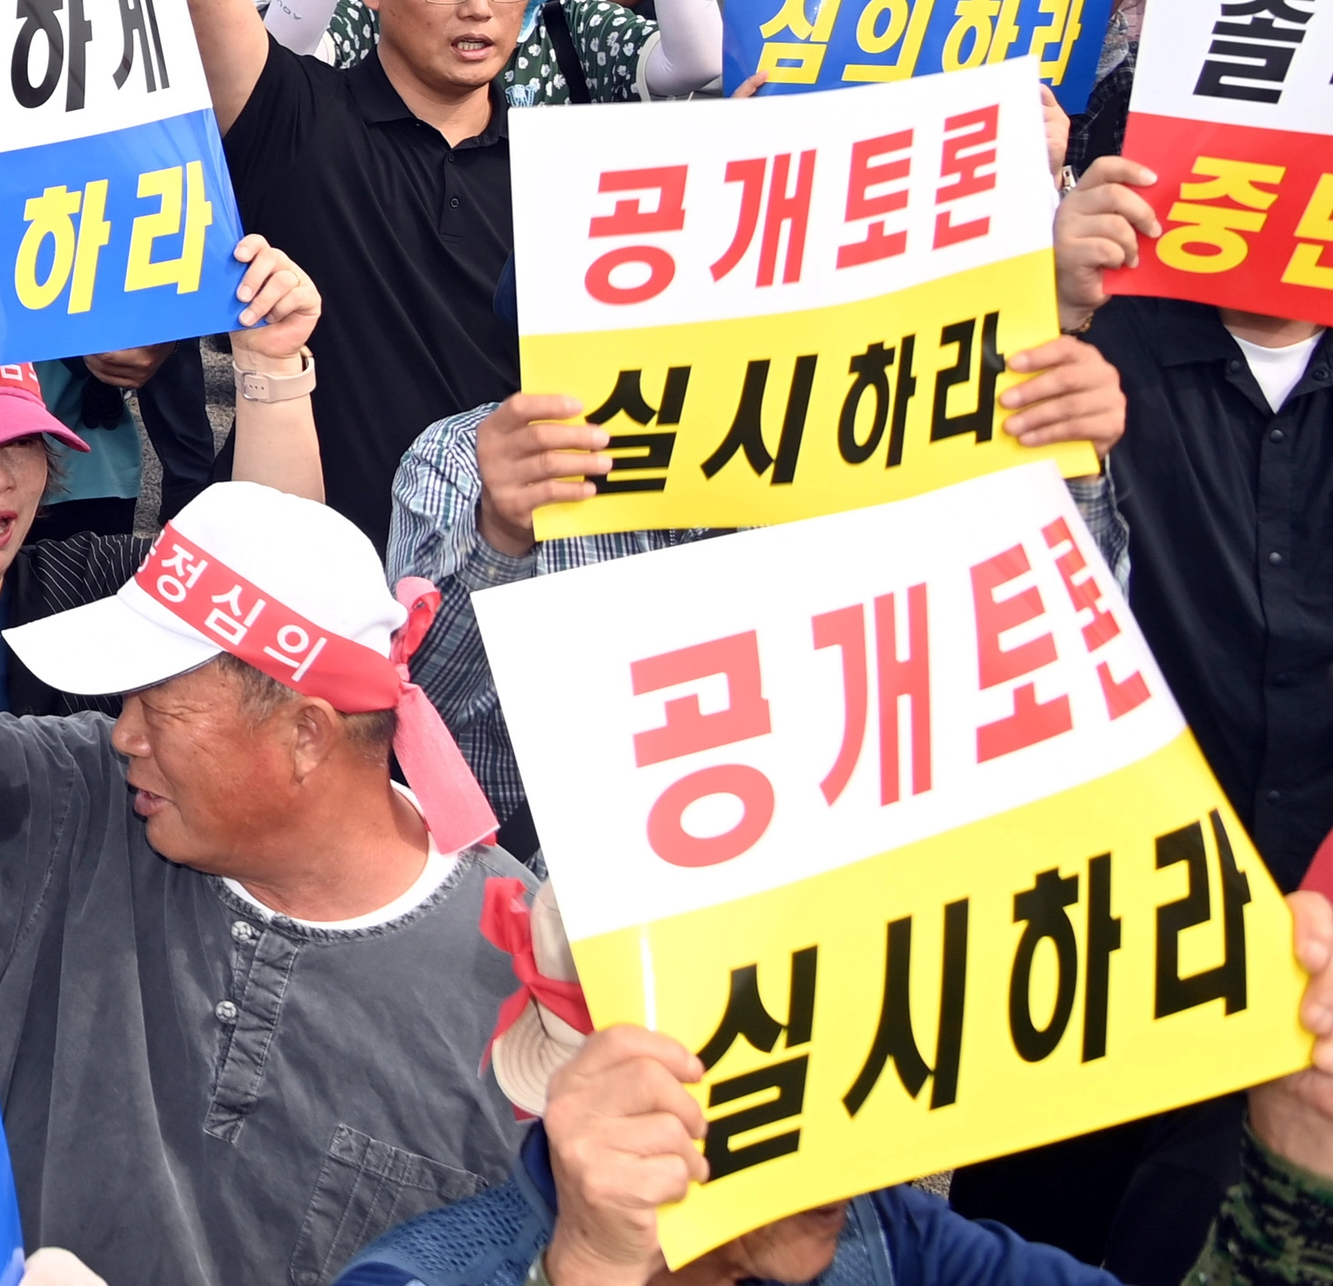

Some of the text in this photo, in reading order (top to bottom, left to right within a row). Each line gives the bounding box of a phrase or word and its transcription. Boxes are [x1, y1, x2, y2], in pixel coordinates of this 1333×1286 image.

[582, 103, 1002, 307] 공개토론
[581, 309, 1007, 497] 실시하라
[628, 513, 1153, 870] 공개토론
[699, 807, 1253, 1187] 실시하라
